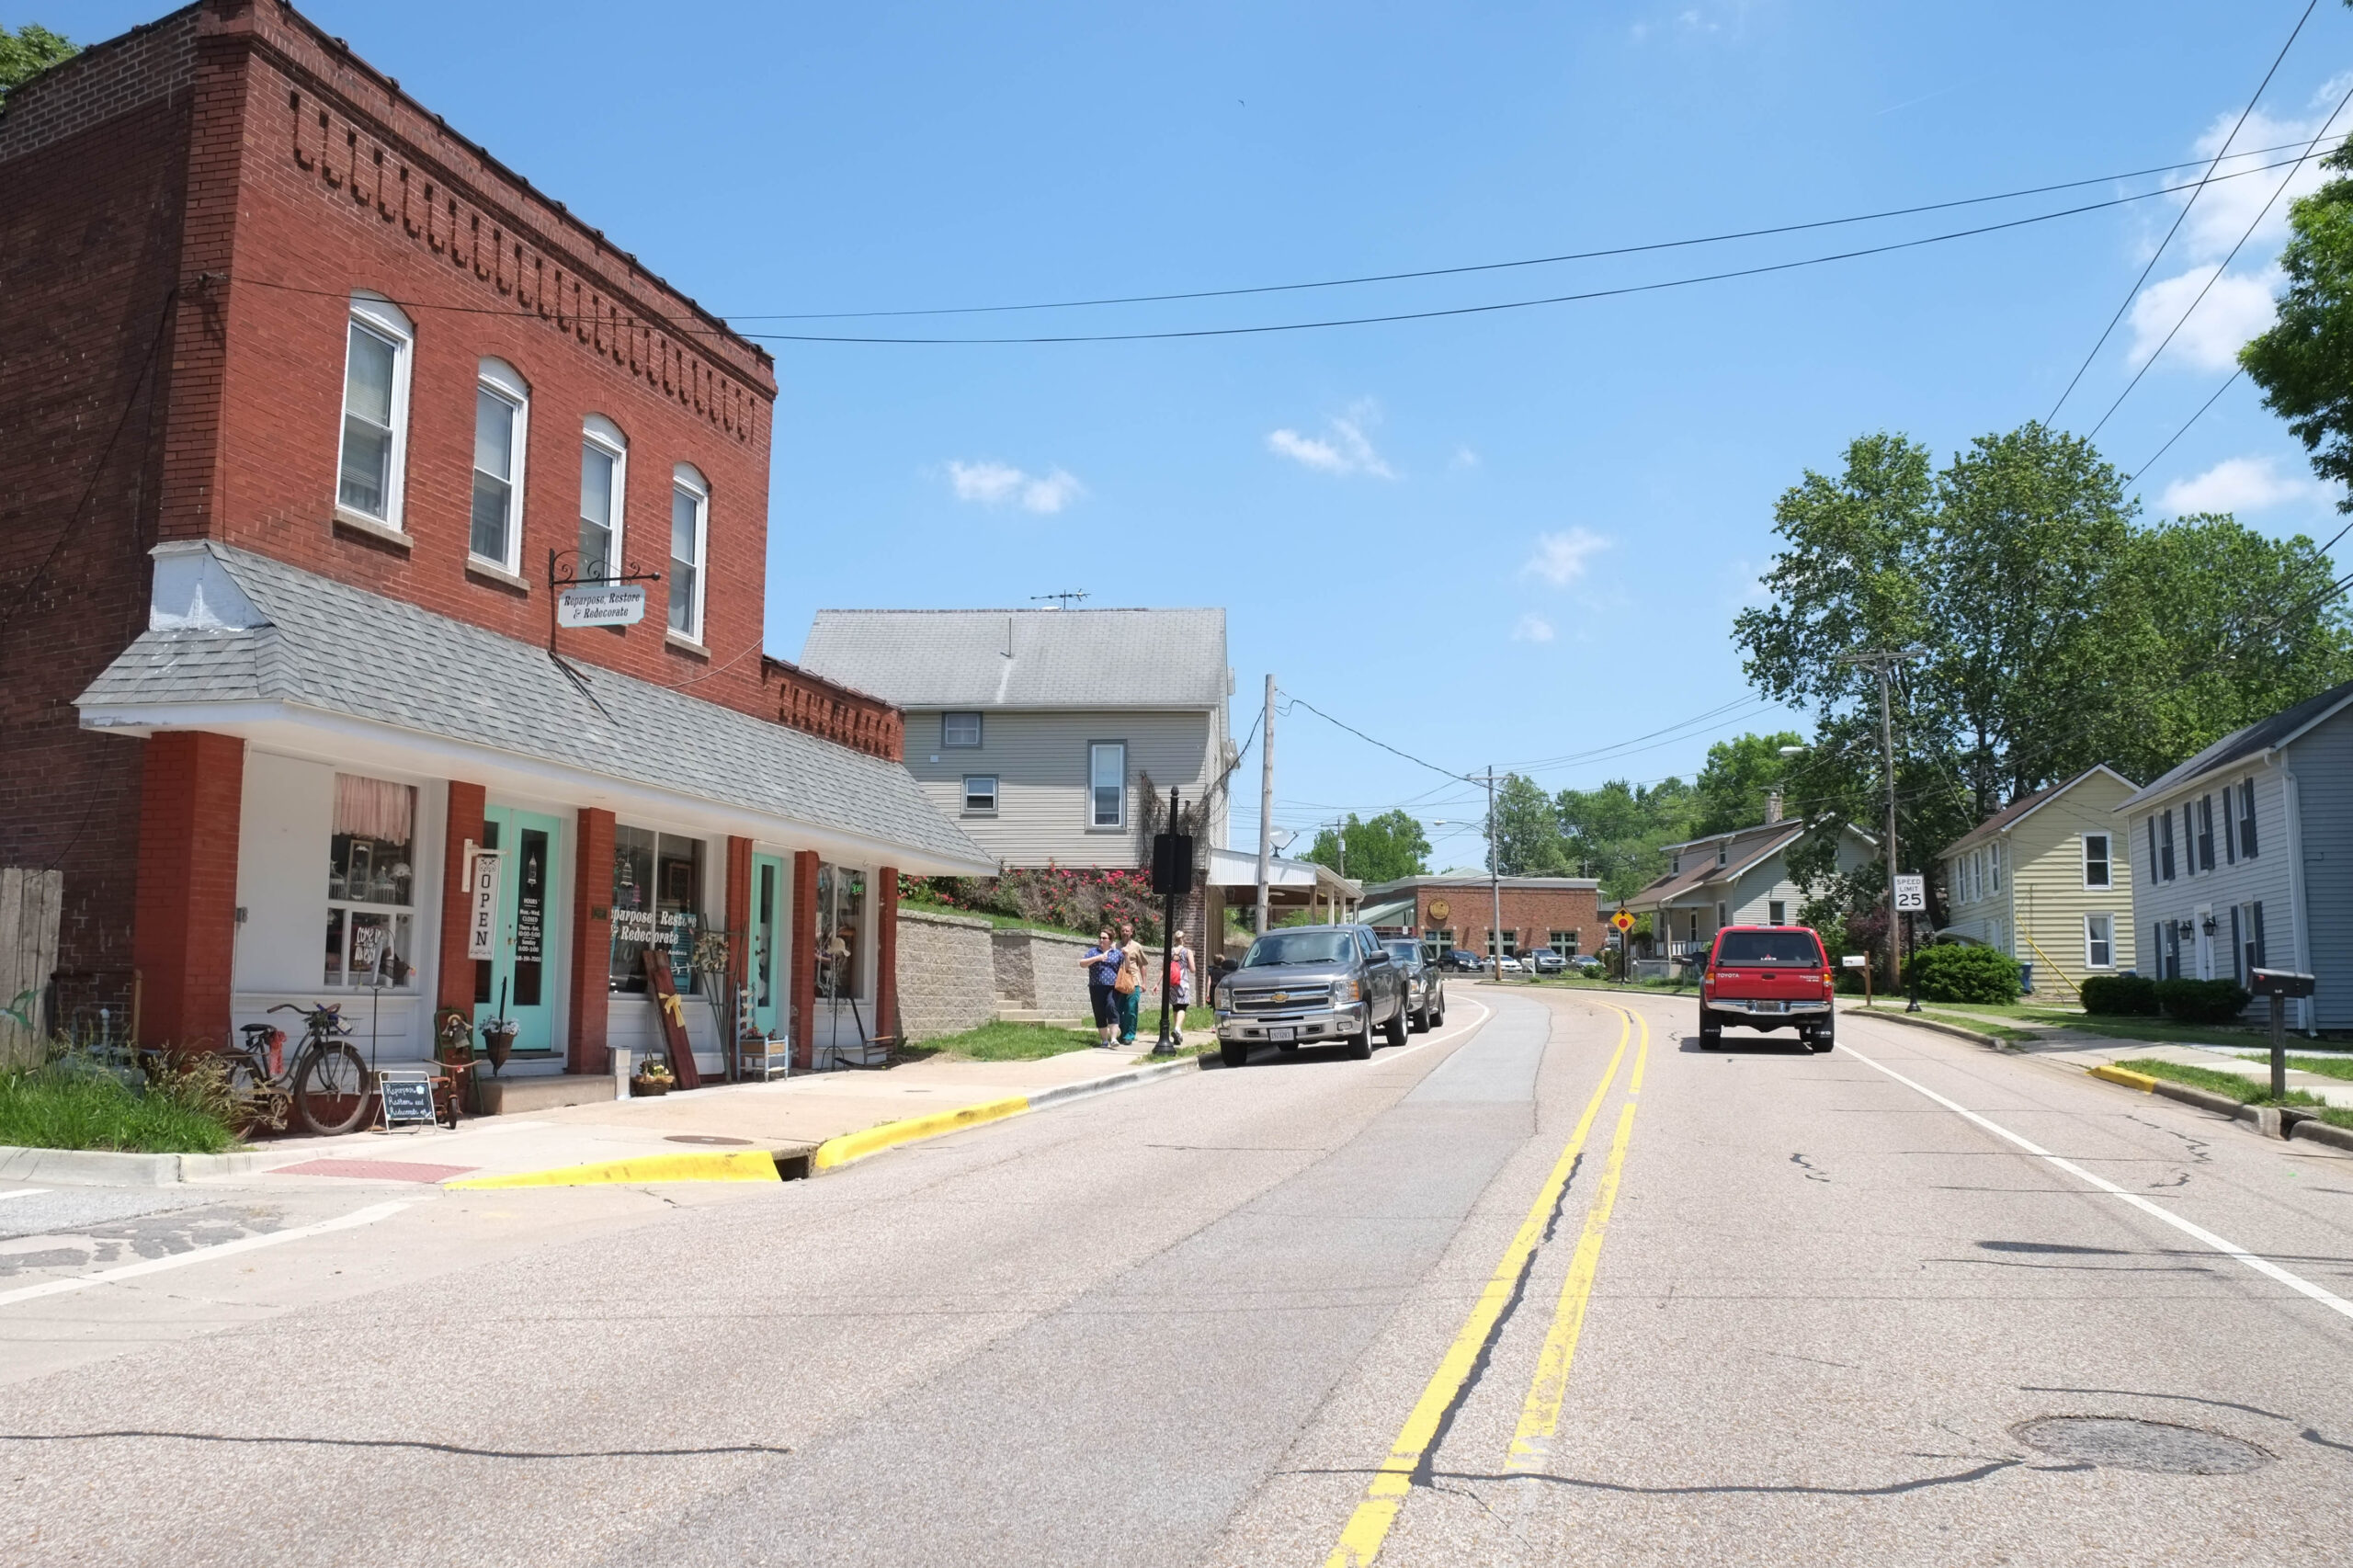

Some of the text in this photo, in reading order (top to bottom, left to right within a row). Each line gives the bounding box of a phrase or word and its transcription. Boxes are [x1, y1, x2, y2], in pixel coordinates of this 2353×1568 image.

[609, 593, 641, 603] Restore
[574, 607, 629, 619] & Redecorate
[1898, 893, 1921, 906] 25
[475, 874, 490, 946] OPEN
